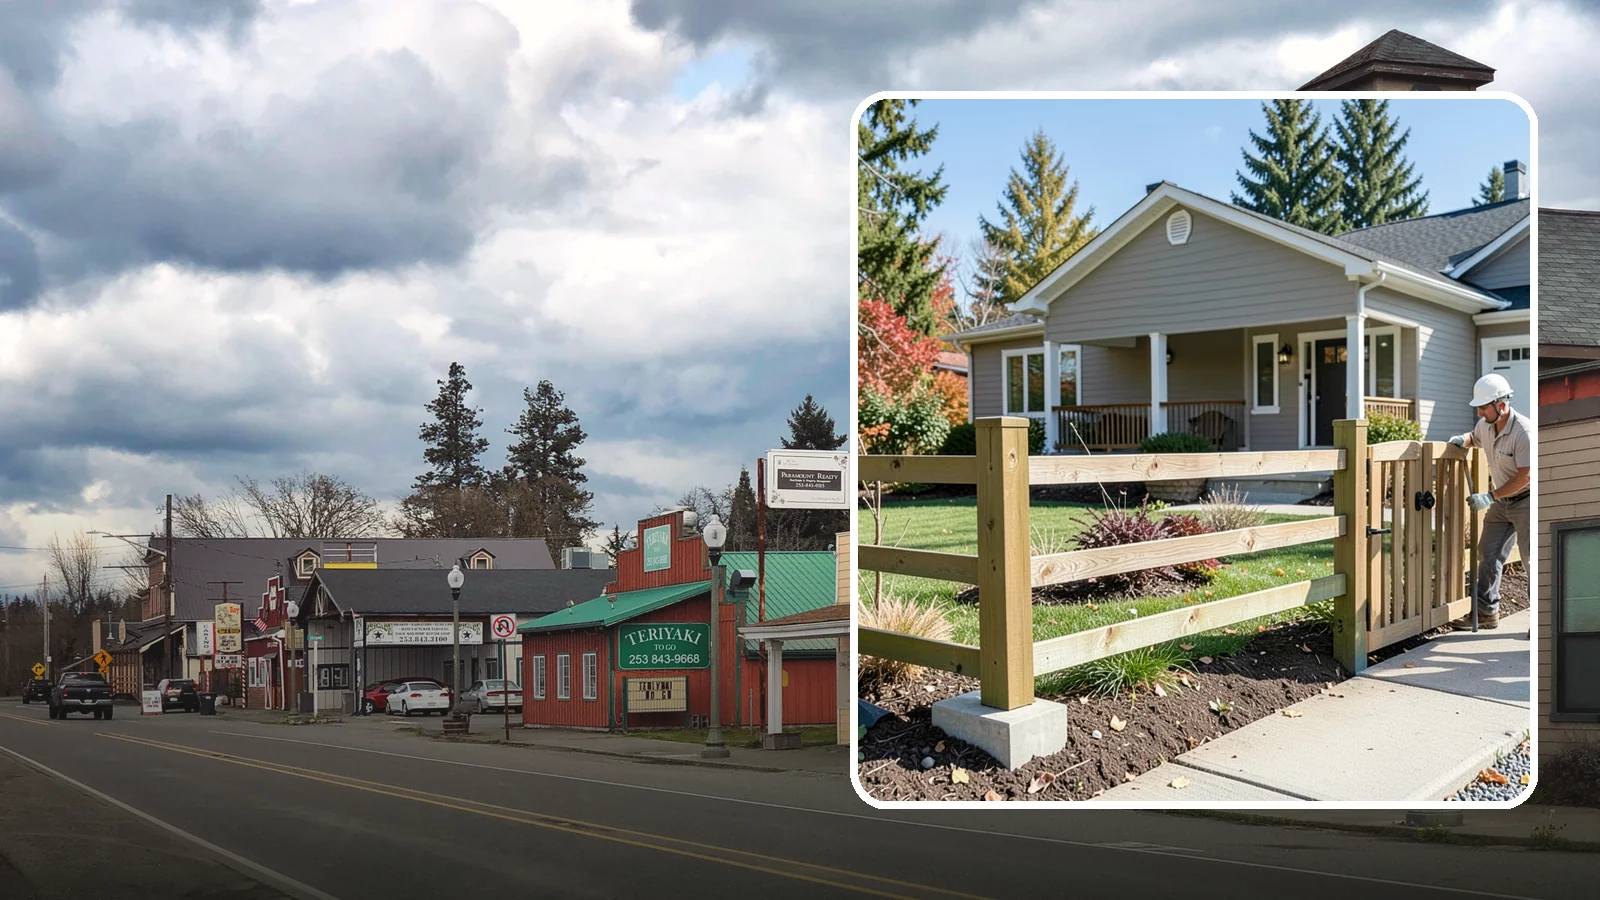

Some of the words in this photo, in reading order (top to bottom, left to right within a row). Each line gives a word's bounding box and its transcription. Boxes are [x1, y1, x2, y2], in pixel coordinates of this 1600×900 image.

[625, 627, 702, 645] TERIYAKI
[629, 654, 648, 664] 253
[652, 654, 700, 663] 843-9668
